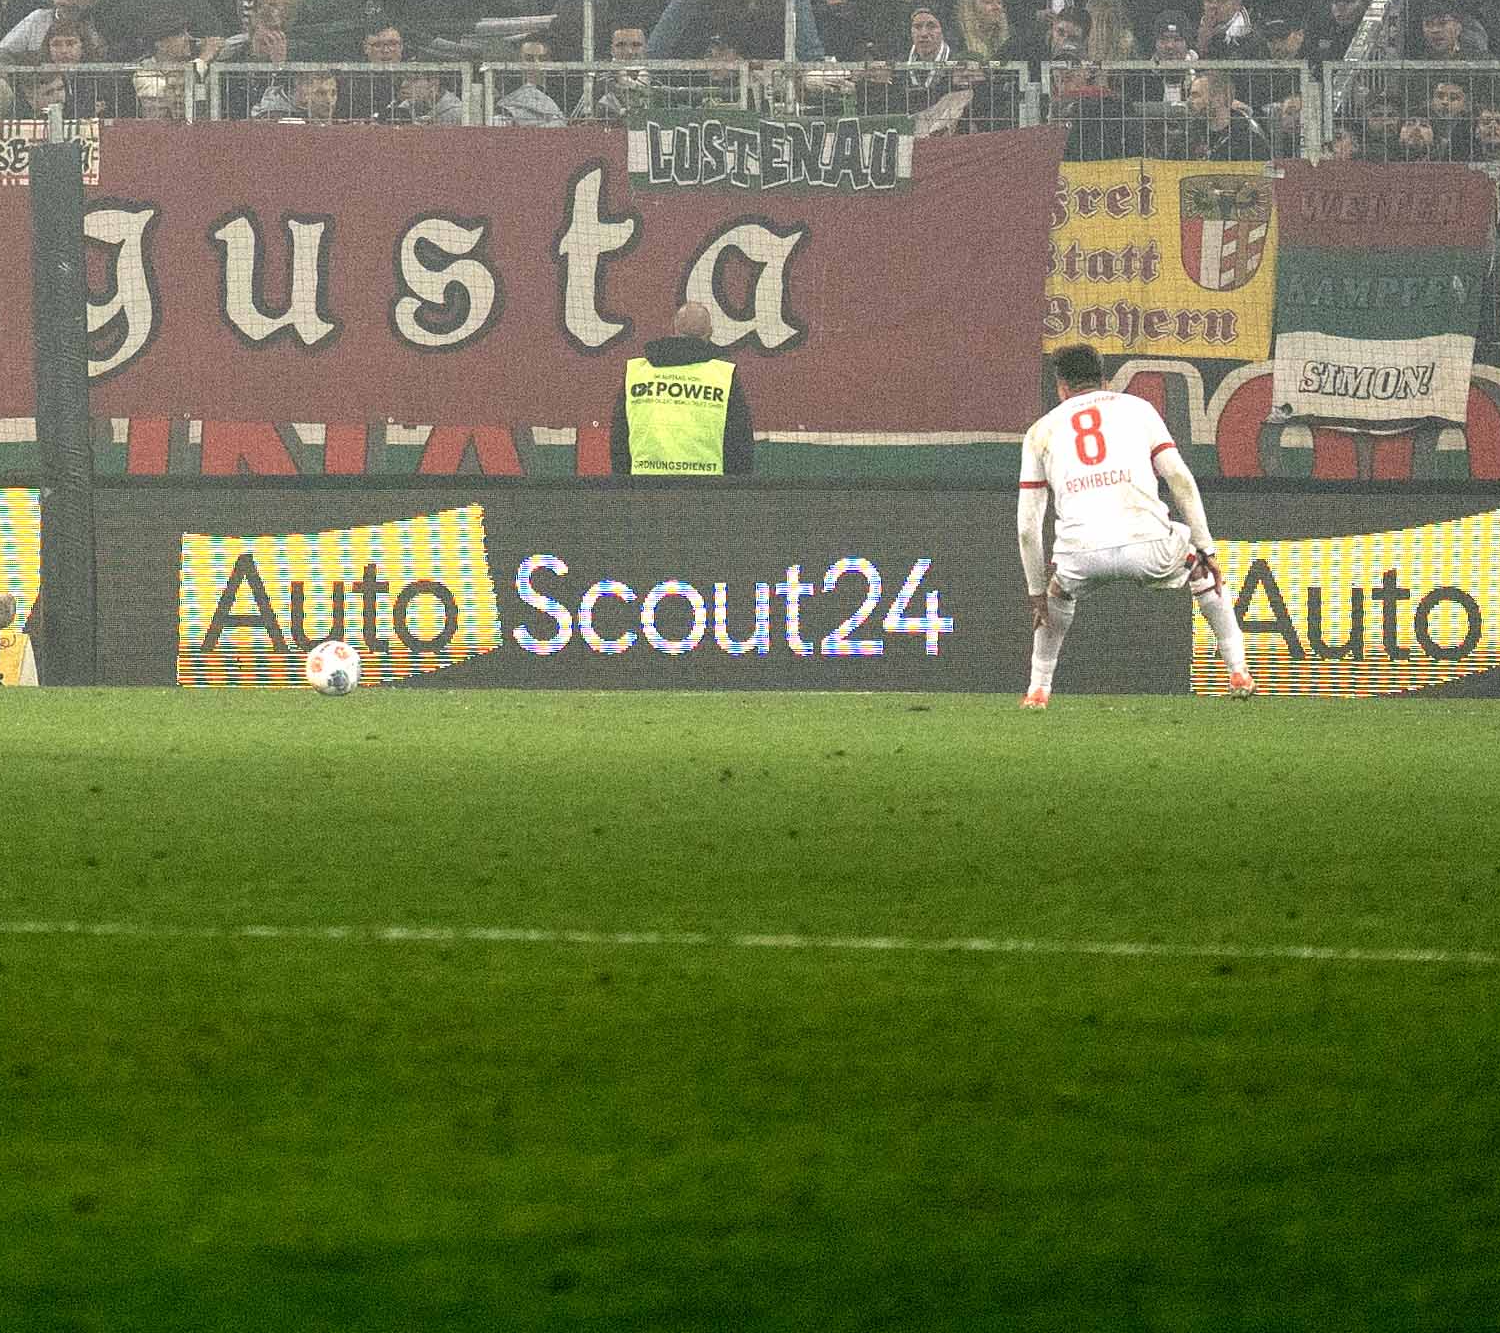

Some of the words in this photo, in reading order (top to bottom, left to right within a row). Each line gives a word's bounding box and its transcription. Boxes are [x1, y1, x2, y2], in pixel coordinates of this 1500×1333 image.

[648, 118, 899, 190] LUSTENAU
[656, 382, 725, 403] POWER
[1299, 360, 1436, 400] SIMON!
[633, 460, 718, 472] ORDNUNGSDIENST
[1070, 405, 1107, 466] 8
[200, 553, 461, 653] Auto
[513, 553, 954, 658] Scout24
[1231, 558, 1482, 663] Auto
